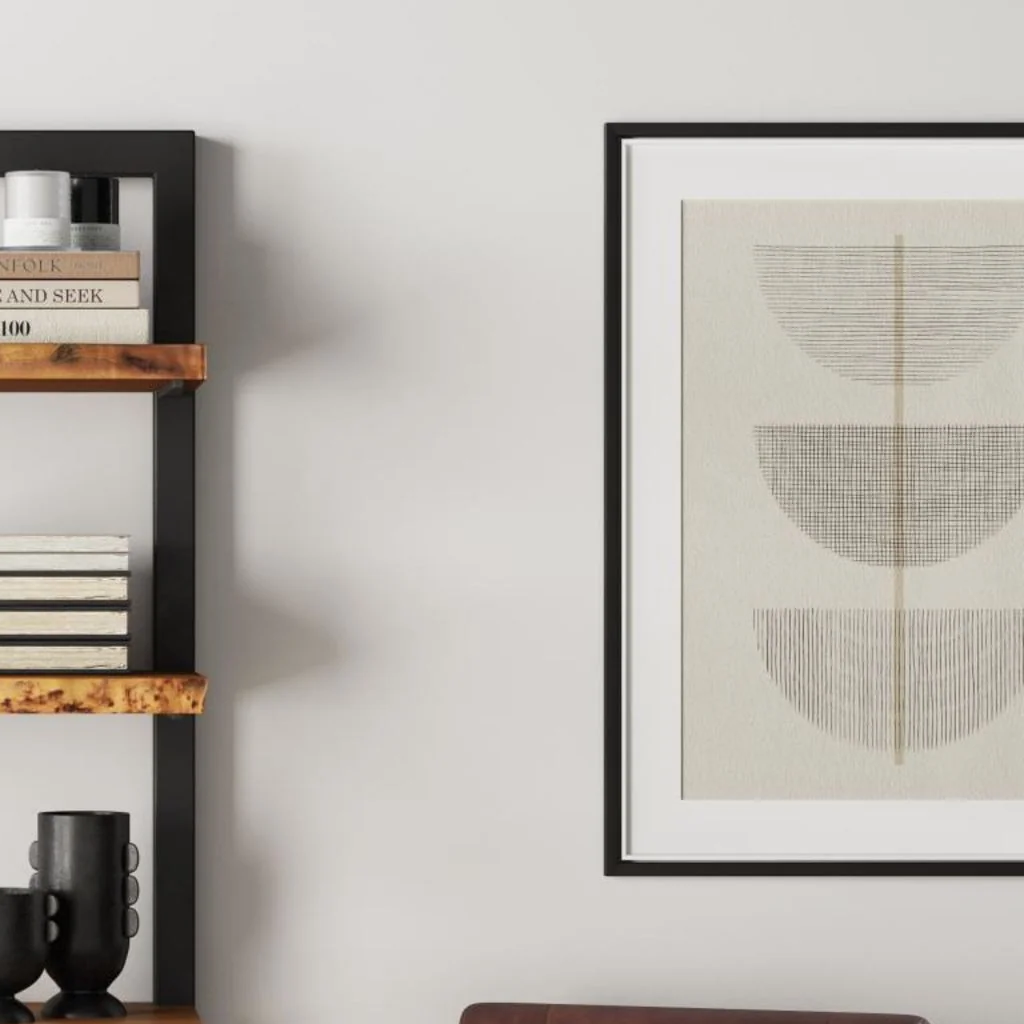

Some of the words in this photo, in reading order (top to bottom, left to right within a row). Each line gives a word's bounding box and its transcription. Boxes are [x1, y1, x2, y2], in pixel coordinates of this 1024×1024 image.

[6, 288, 48, 304] AND
[52, 288, 104, 304] SEEK
[0, 319, 31, 337] 100
